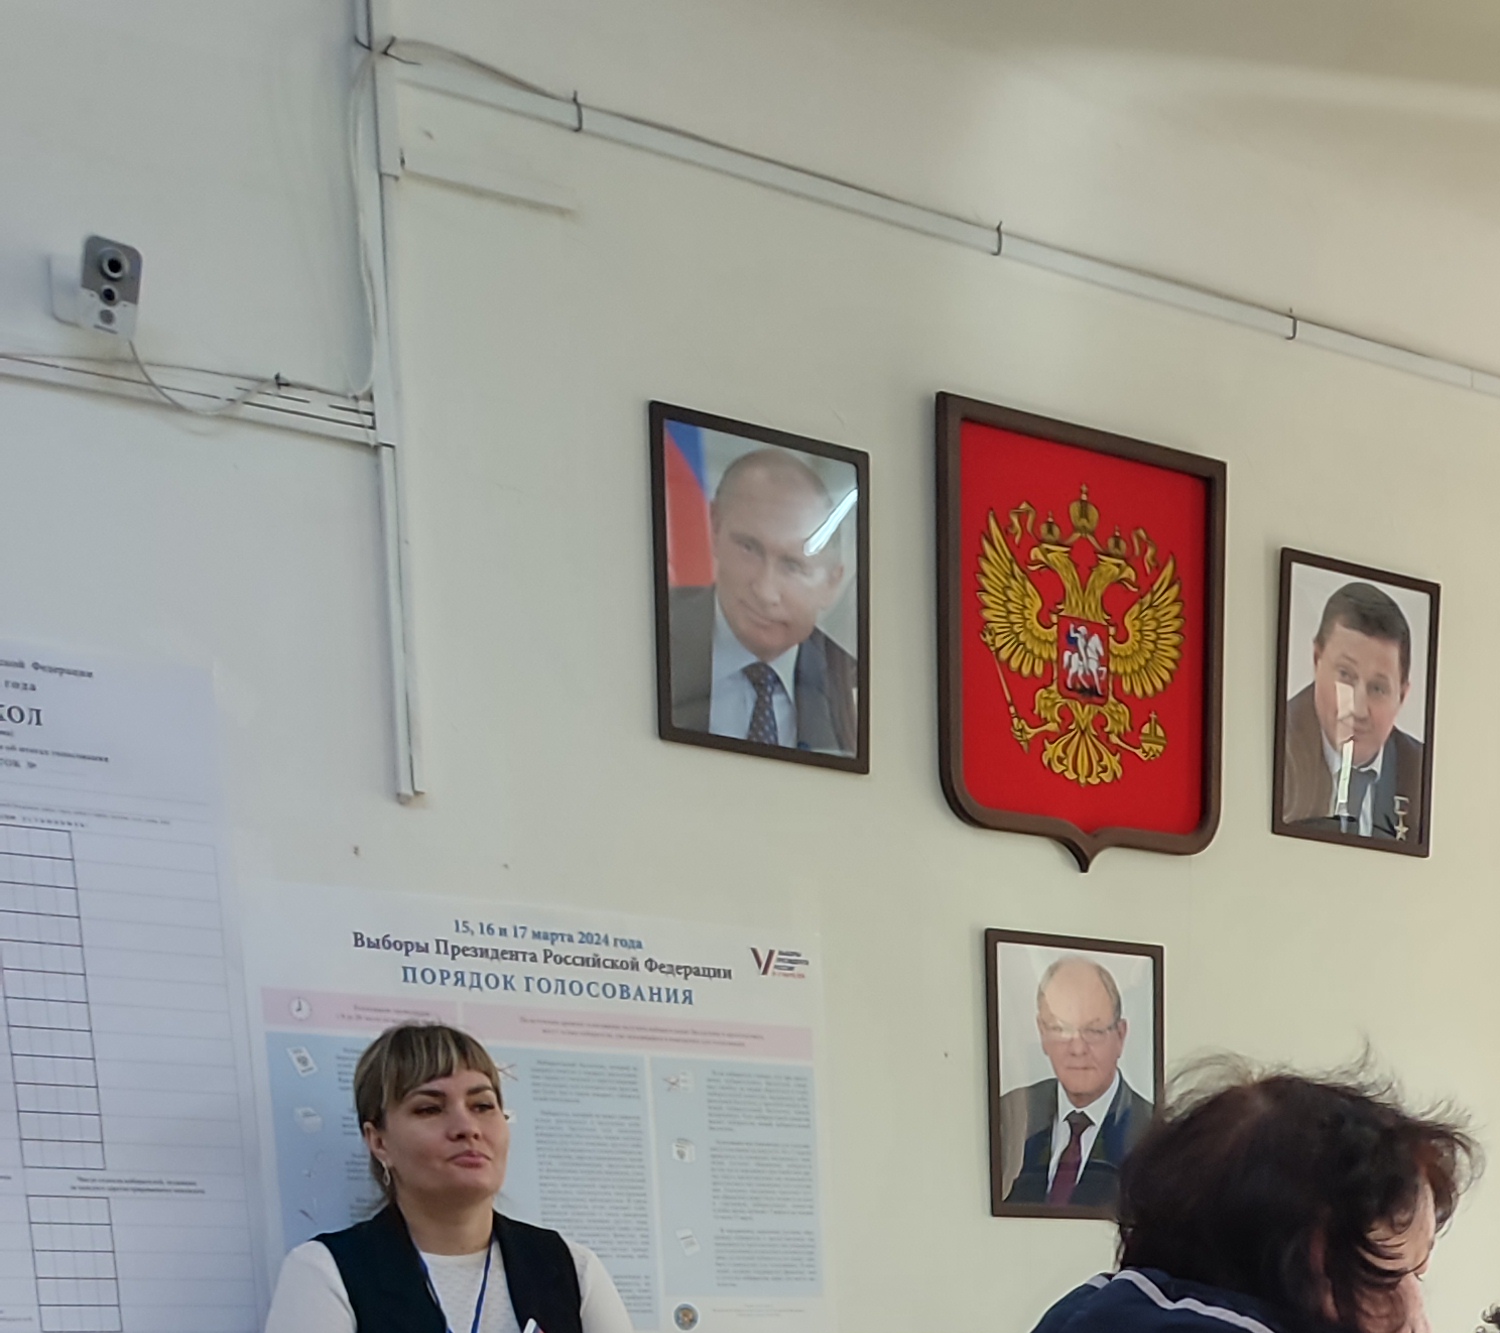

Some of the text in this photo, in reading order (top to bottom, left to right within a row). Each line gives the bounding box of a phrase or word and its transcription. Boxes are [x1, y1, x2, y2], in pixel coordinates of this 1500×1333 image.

[454, 919, 643, 950] 15, 16 и 17 марта 2024 года
[352, 931, 732, 980] Выборы Президента Российской Федерации
[402, 966, 694, 1005] ПОРЯДОК ГОЛОСОВАНИЯ
